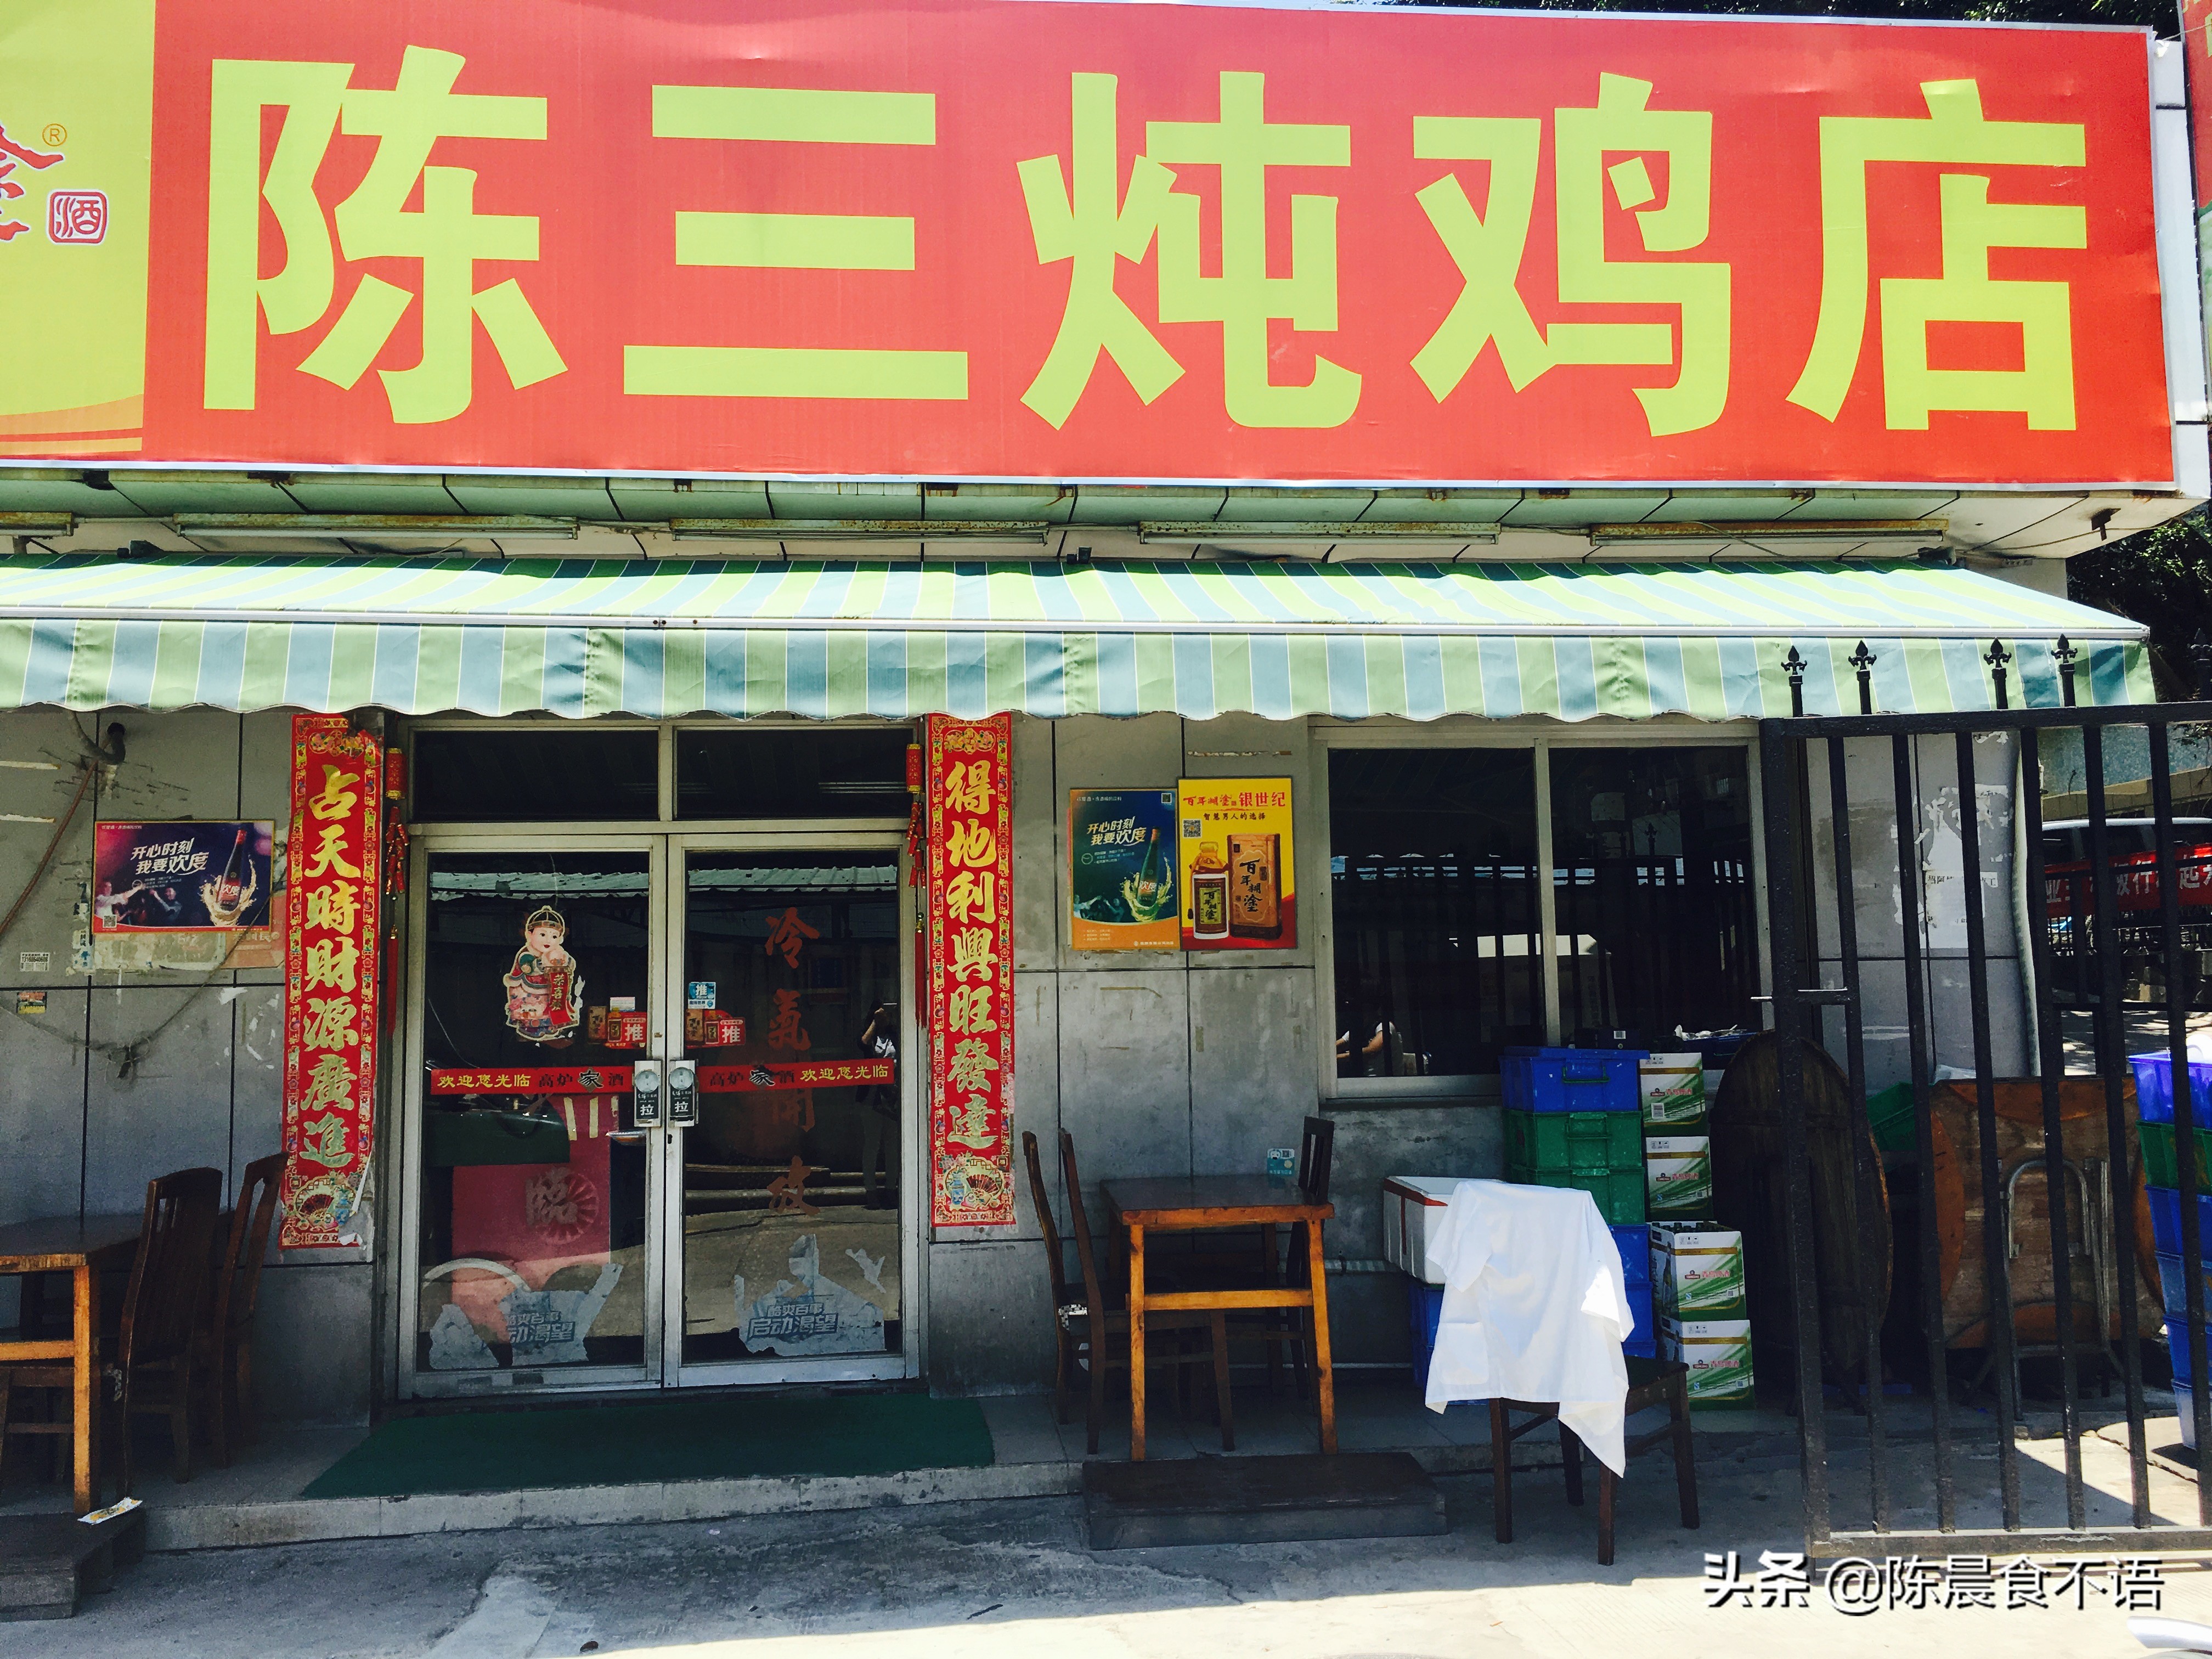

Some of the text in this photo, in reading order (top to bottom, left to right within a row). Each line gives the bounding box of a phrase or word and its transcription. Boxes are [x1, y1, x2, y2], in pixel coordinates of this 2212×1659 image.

[203, 45, 2087, 436] 陈三炖鸡店
[1239, 792, 1286, 807] 银世纪
[1203, 812, 1266, 821] 智慧男人的选择
[1087, 816, 1136, 835] 开心时刻
[1091, 827, 1147, 847] 我要欢度
[131, 837, 195, 860] 开心时刻
[136, 851, 210, 876] 我要欢度
[299, 764, 362, 1168] 占天時財源廣進
[695, 984, 708, 996] 推
[624, 1024, 643, 1041] 推
[721, 1026, 741, 1043] 推
[437, 1074, 531, 1088] 欢迎您光临
[799, 1064, 889, 1082] 欢迎您光临
[640, 1104, 654, 1116] 拉
[674, 1101, 689, 1113] 拉
[748, 1314, 838, 1338] 启动渴望
